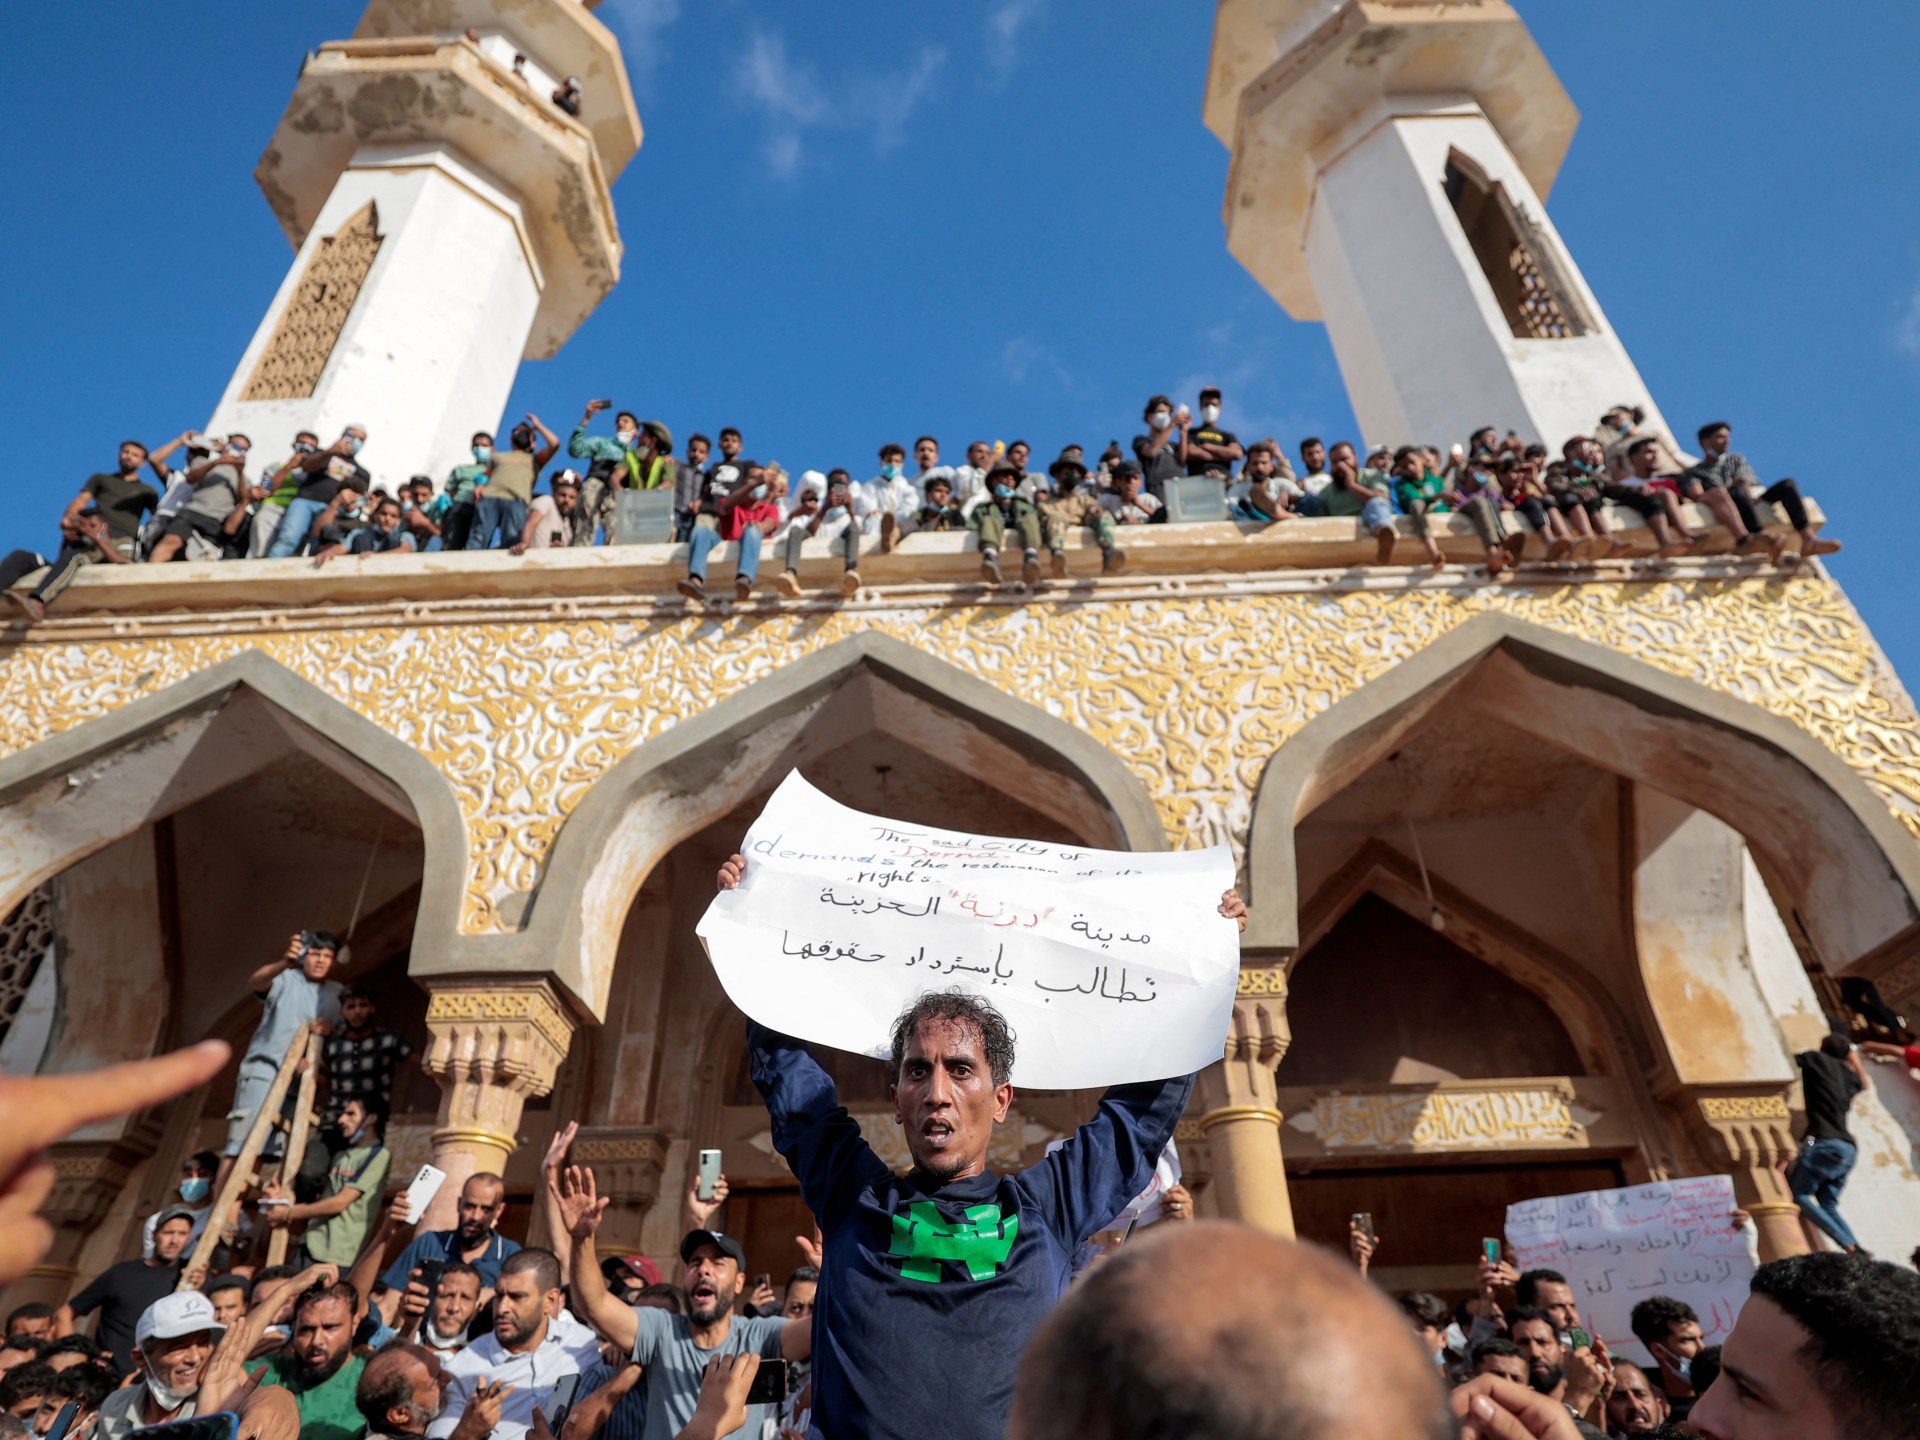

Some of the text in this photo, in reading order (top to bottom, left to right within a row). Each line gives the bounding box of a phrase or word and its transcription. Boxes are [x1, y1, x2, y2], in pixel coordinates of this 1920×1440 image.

[753, 833, 896, 866] demands
[911, 858, 949, 869] the
[871, 827, 928, 844] The
[931, 838, 972, 848] sad
[980, 838, 1049, 856] City
[819, 887, 941, 917] الحزينة
[781, 929, 887, 962] حقوقها
[1070, 913, 1151, 950] مدينة
[1034, 965, 1157, 1004] تطالب
